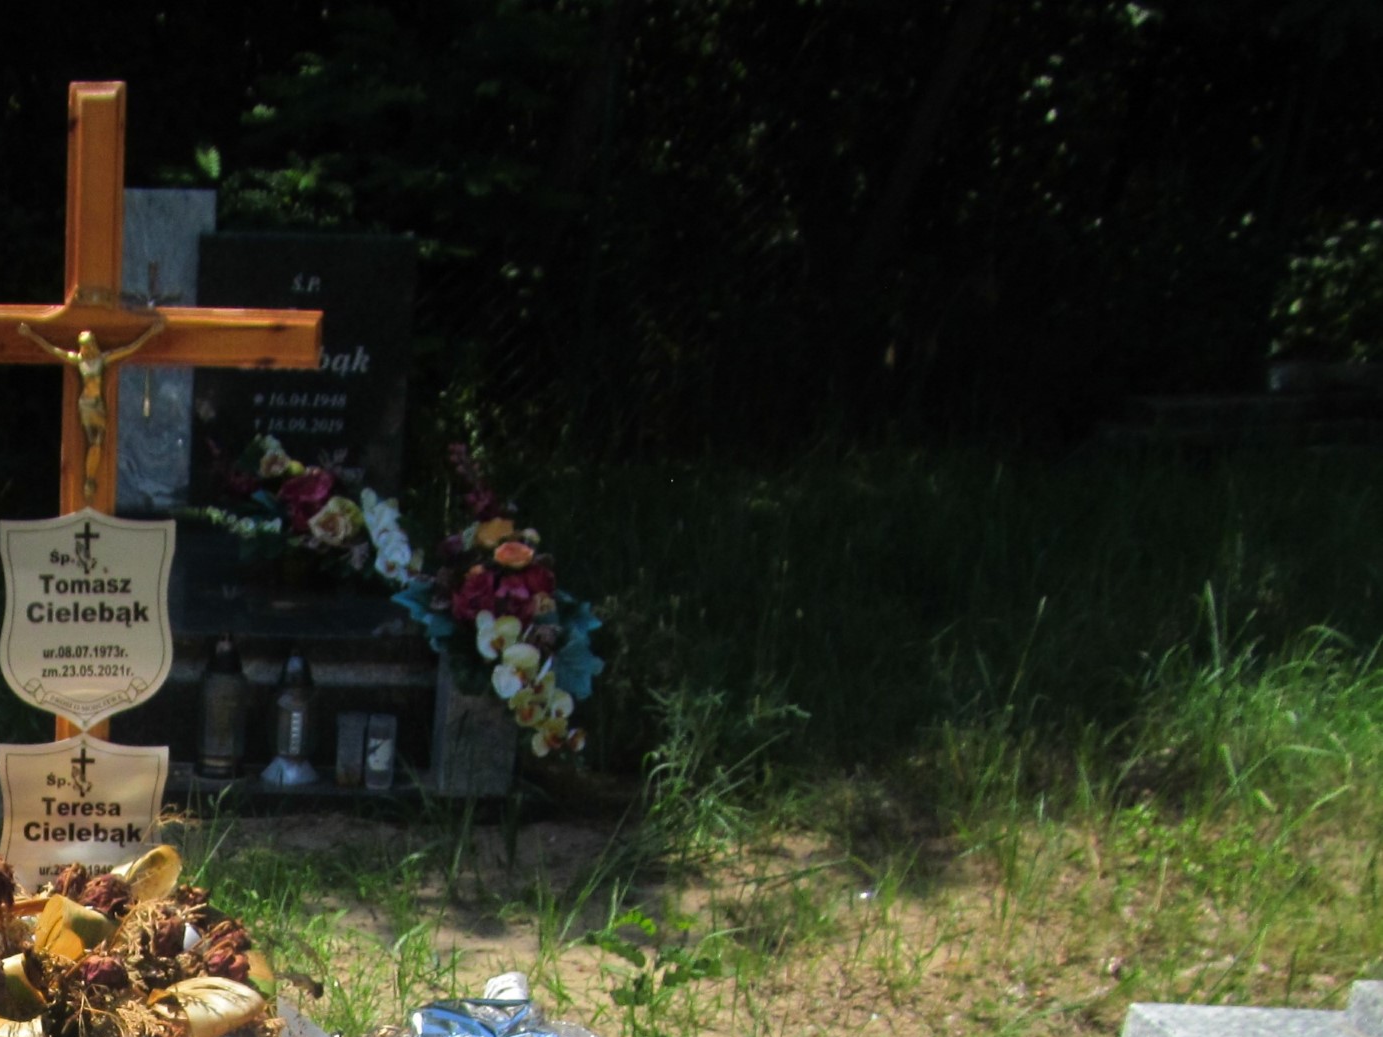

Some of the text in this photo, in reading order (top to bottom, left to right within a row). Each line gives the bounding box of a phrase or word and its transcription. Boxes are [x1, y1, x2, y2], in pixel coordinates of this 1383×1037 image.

[39, 574, 131, 594] Tomasz
[26, 602, 149, 628] Cielebąk
[43, 645, 129, 659] ur.08.07.1973r.
[41, 664, 134, 678] zm.23.05.2021r.
[42, 797, 121, 816] Teresa
[23, 821, 142, 848] Cielebąk
